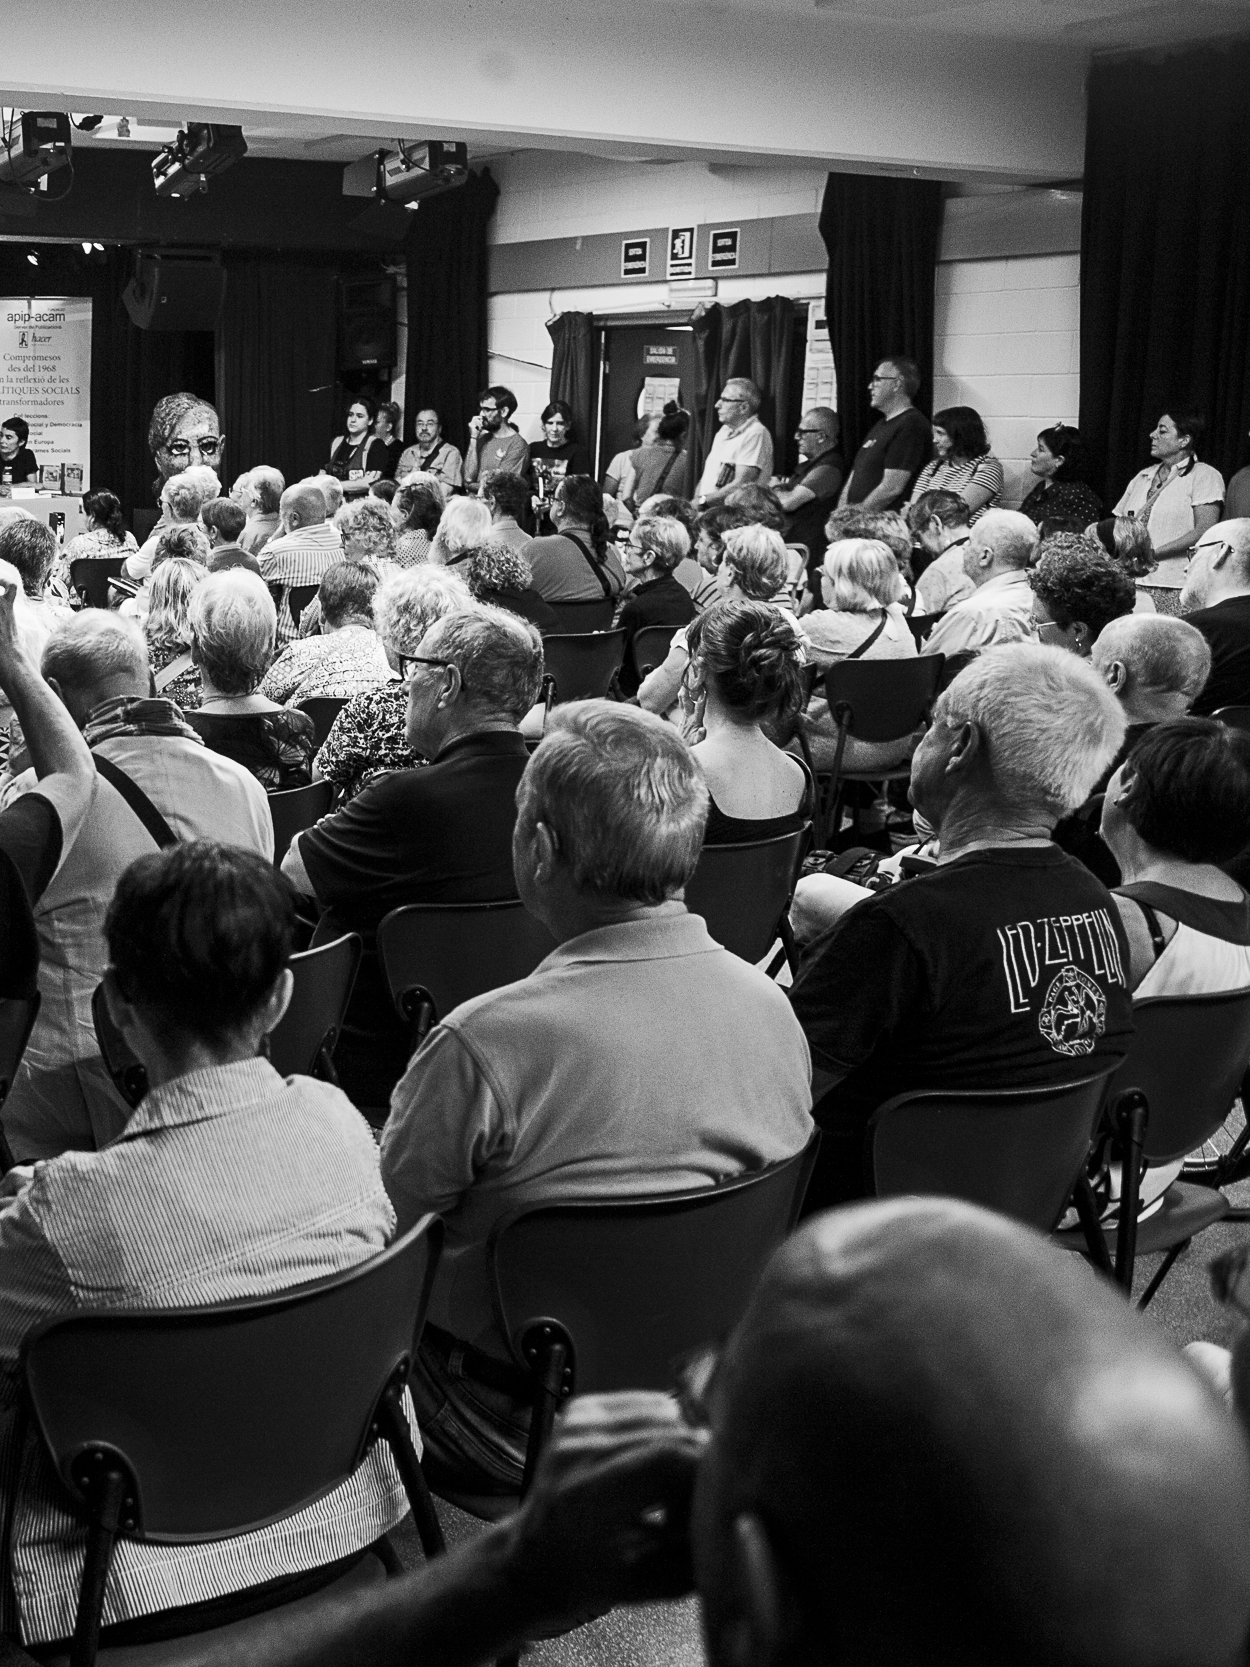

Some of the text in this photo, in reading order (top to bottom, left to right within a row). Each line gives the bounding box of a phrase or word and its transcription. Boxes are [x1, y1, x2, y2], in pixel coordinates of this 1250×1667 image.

[7, 310, 66, 324] apip-acam
[31, 332, 53, 343] hacer
[3, 353, 62, 363] Compromesos
[7, 364, 57, 373] des del 1968
[6, 375, 13, 384] la
[15, 375, 44, 384] reflexió
[47, 375, 57, 384] de
[59, 375, 70, 384] les
[41, 386, 81, 395] SOCIALS
[0, 397, 65, 406] transformadores
